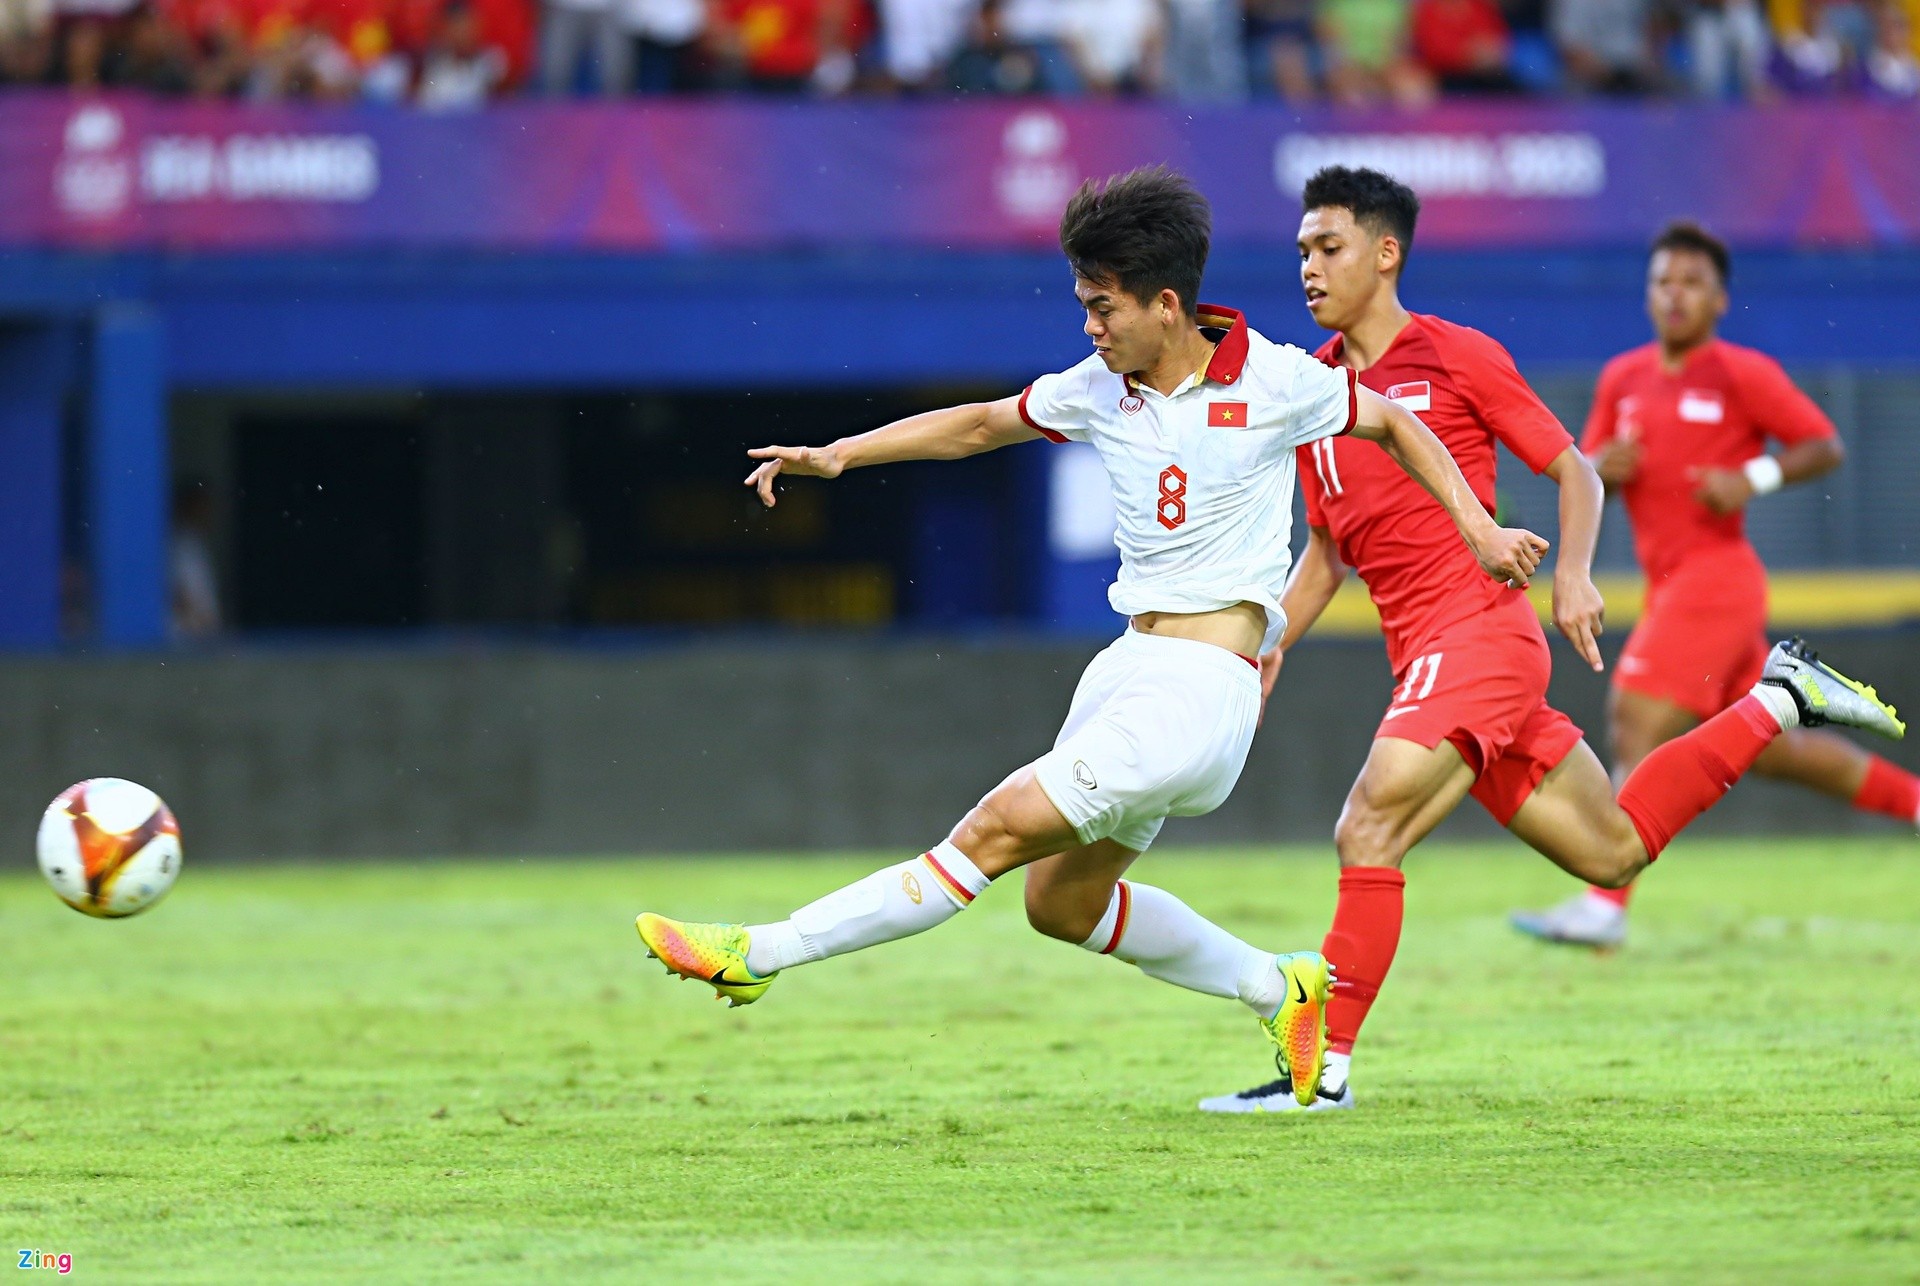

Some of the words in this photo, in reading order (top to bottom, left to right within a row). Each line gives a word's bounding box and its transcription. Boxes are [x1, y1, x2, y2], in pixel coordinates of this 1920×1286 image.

[1157, 463, 1188, 530] 8
[1312, 436, 1344, 499] 11
[1399, 652, 1443, 702] 11
